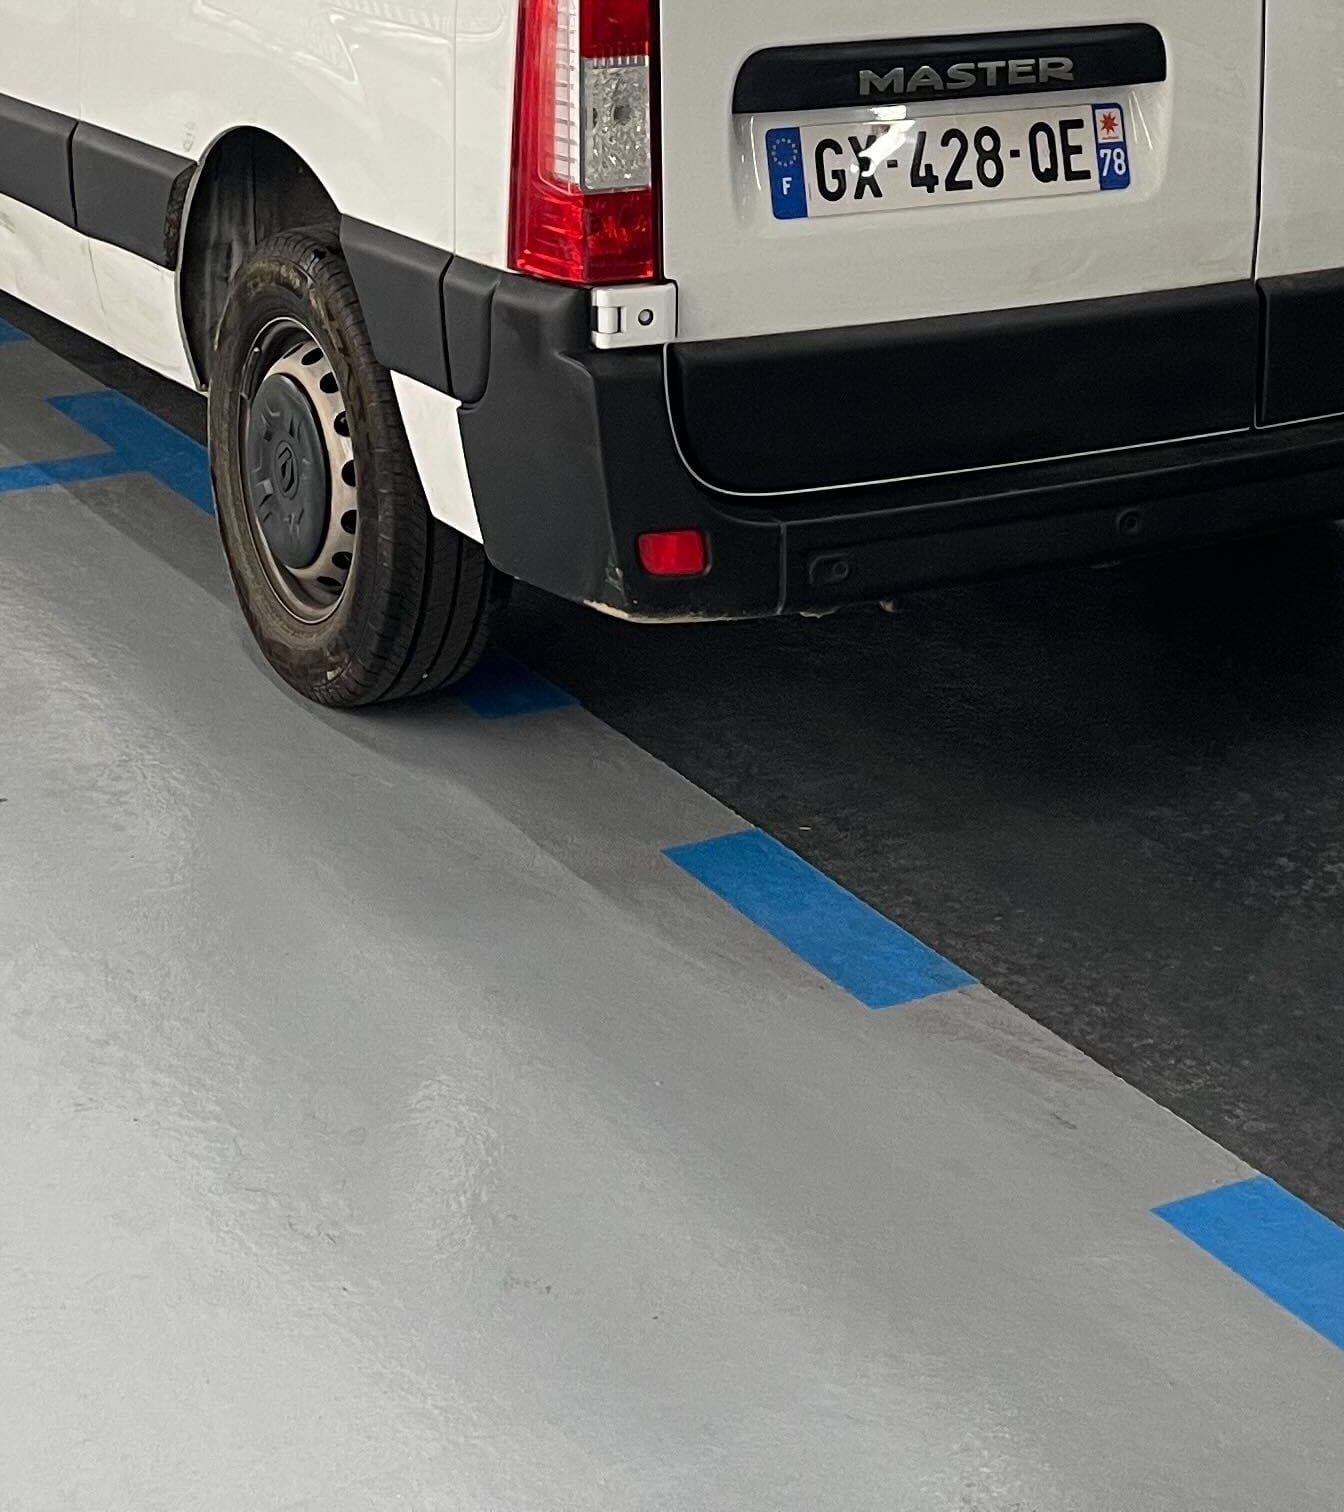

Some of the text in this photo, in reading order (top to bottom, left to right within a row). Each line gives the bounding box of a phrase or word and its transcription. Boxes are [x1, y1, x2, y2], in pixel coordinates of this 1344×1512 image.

[859, 57, 1075, 96] MASTER
[782, 118, 1127, 203] F GX-428-QE 78
